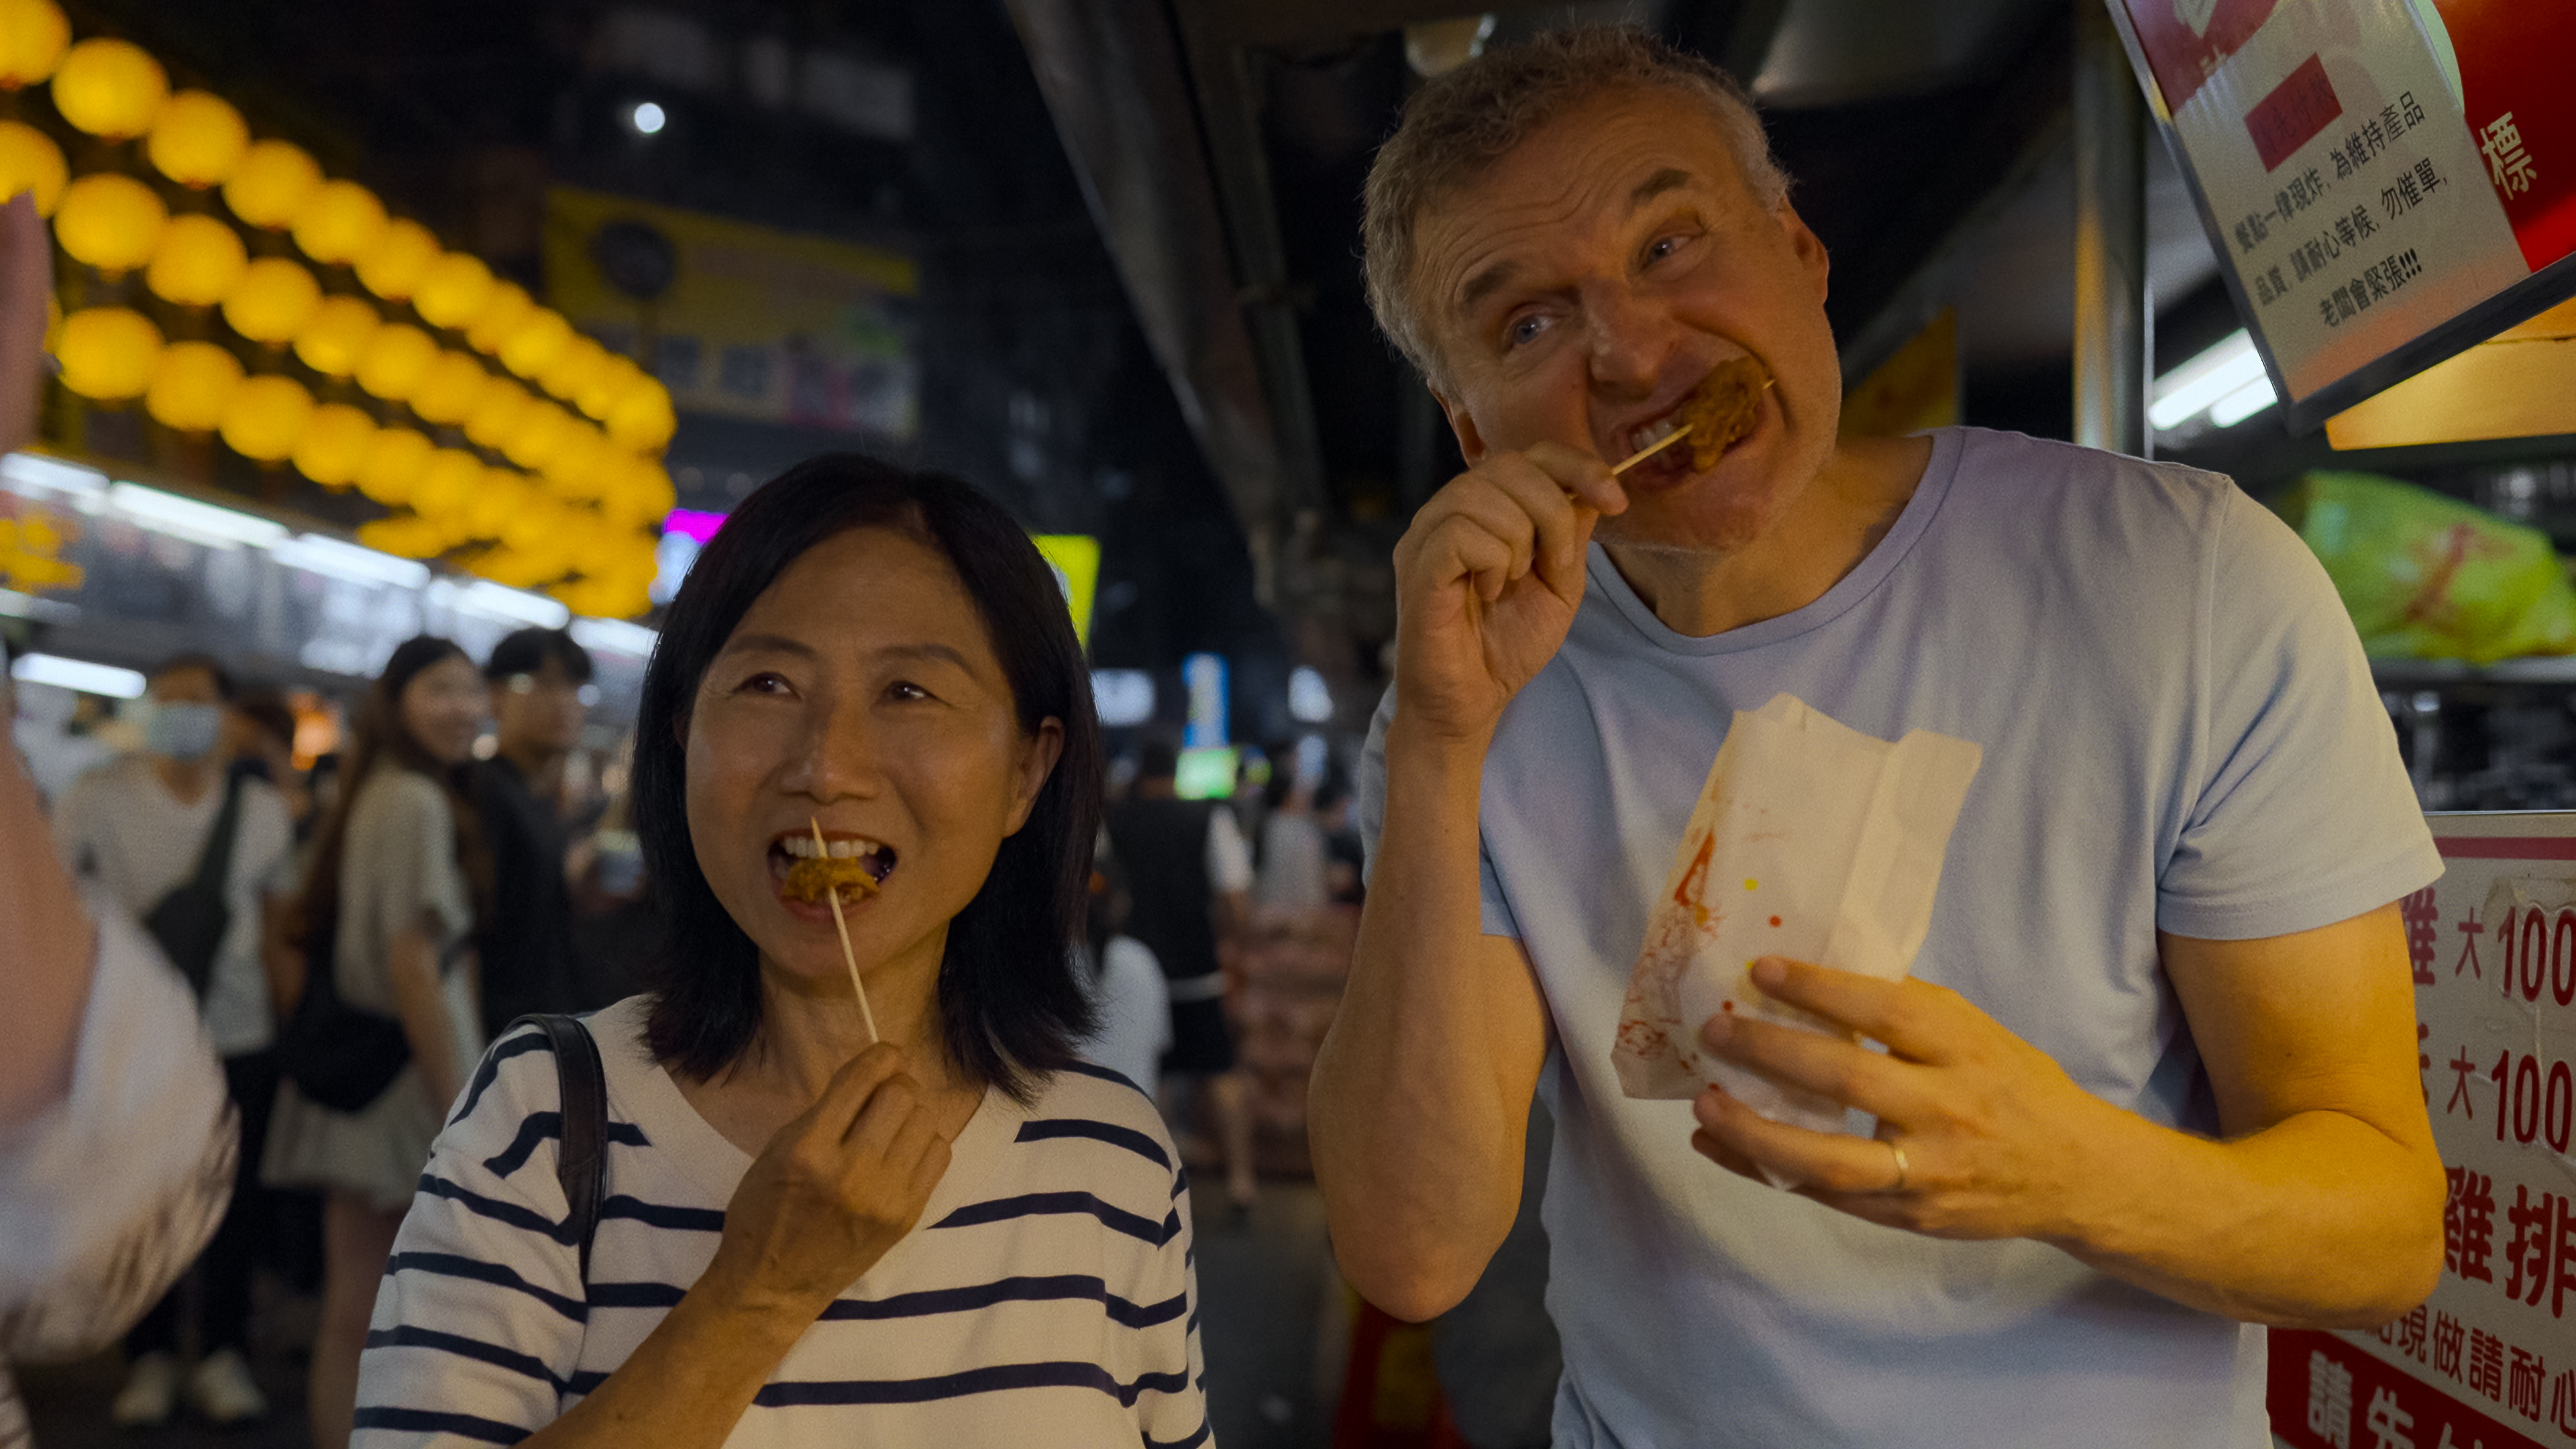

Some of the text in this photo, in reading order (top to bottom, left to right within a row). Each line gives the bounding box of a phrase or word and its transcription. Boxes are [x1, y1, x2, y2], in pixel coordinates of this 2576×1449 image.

[2480, 111, 2537, 201] 標
[2455, 906, 2483, 979] 大
[2497, 906, 2576, 1006] 100
[2447, 1044, 2475, 1120] 大
[2491, 1049, 2573, 1155] 100
[2306, 1349, 2485, 1449] 請先
